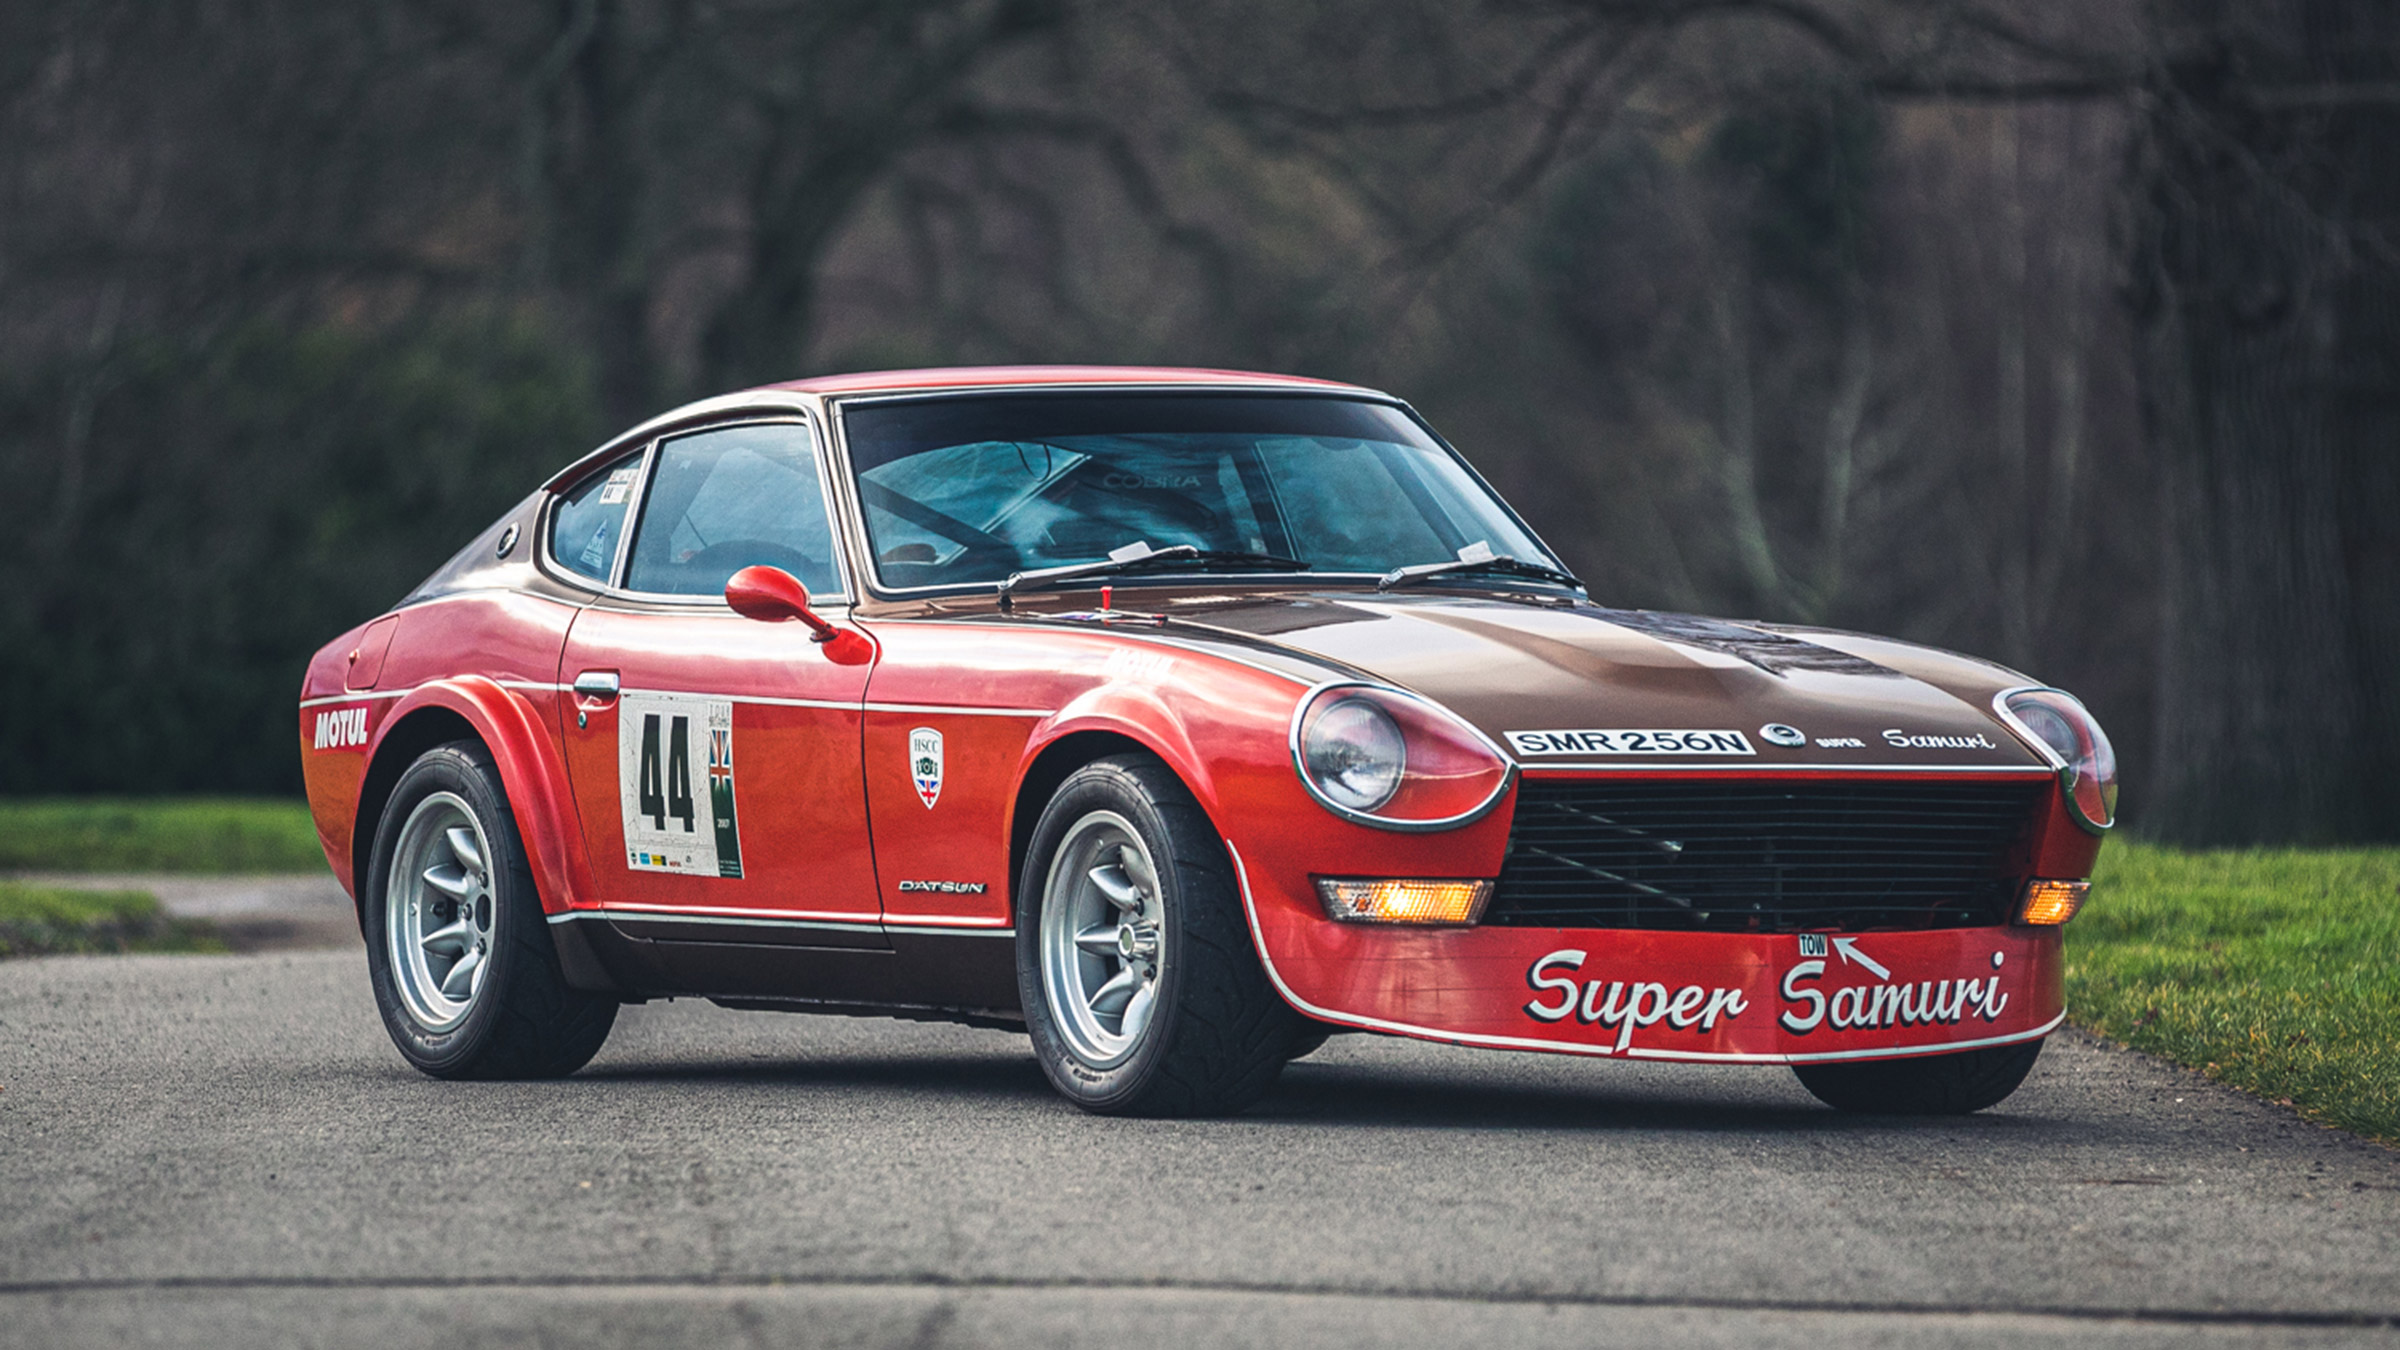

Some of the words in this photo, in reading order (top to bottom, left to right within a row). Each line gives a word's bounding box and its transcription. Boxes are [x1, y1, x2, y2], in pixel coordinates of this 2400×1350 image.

[1103, 473, 1201, 488] COBRA
[314, 707, 368, 749] MOTUL
[914, 739, 939, 752] HSCC
[1517, 732, 1619, 751] SMR
[1620, 731, 1749, 752] 256N
[1815, 738, 1866, 748] SUPER
[1882, 729, 1996, 749] Samuri
[640, 713, 694, 832] 44
[898, 880, 986, 893] DATSUN
[1801, 935, 1825, 954] TOW
[1523, 949, 1749, 1052] Super
[1778, 951, 2008, 1035] Samuri
